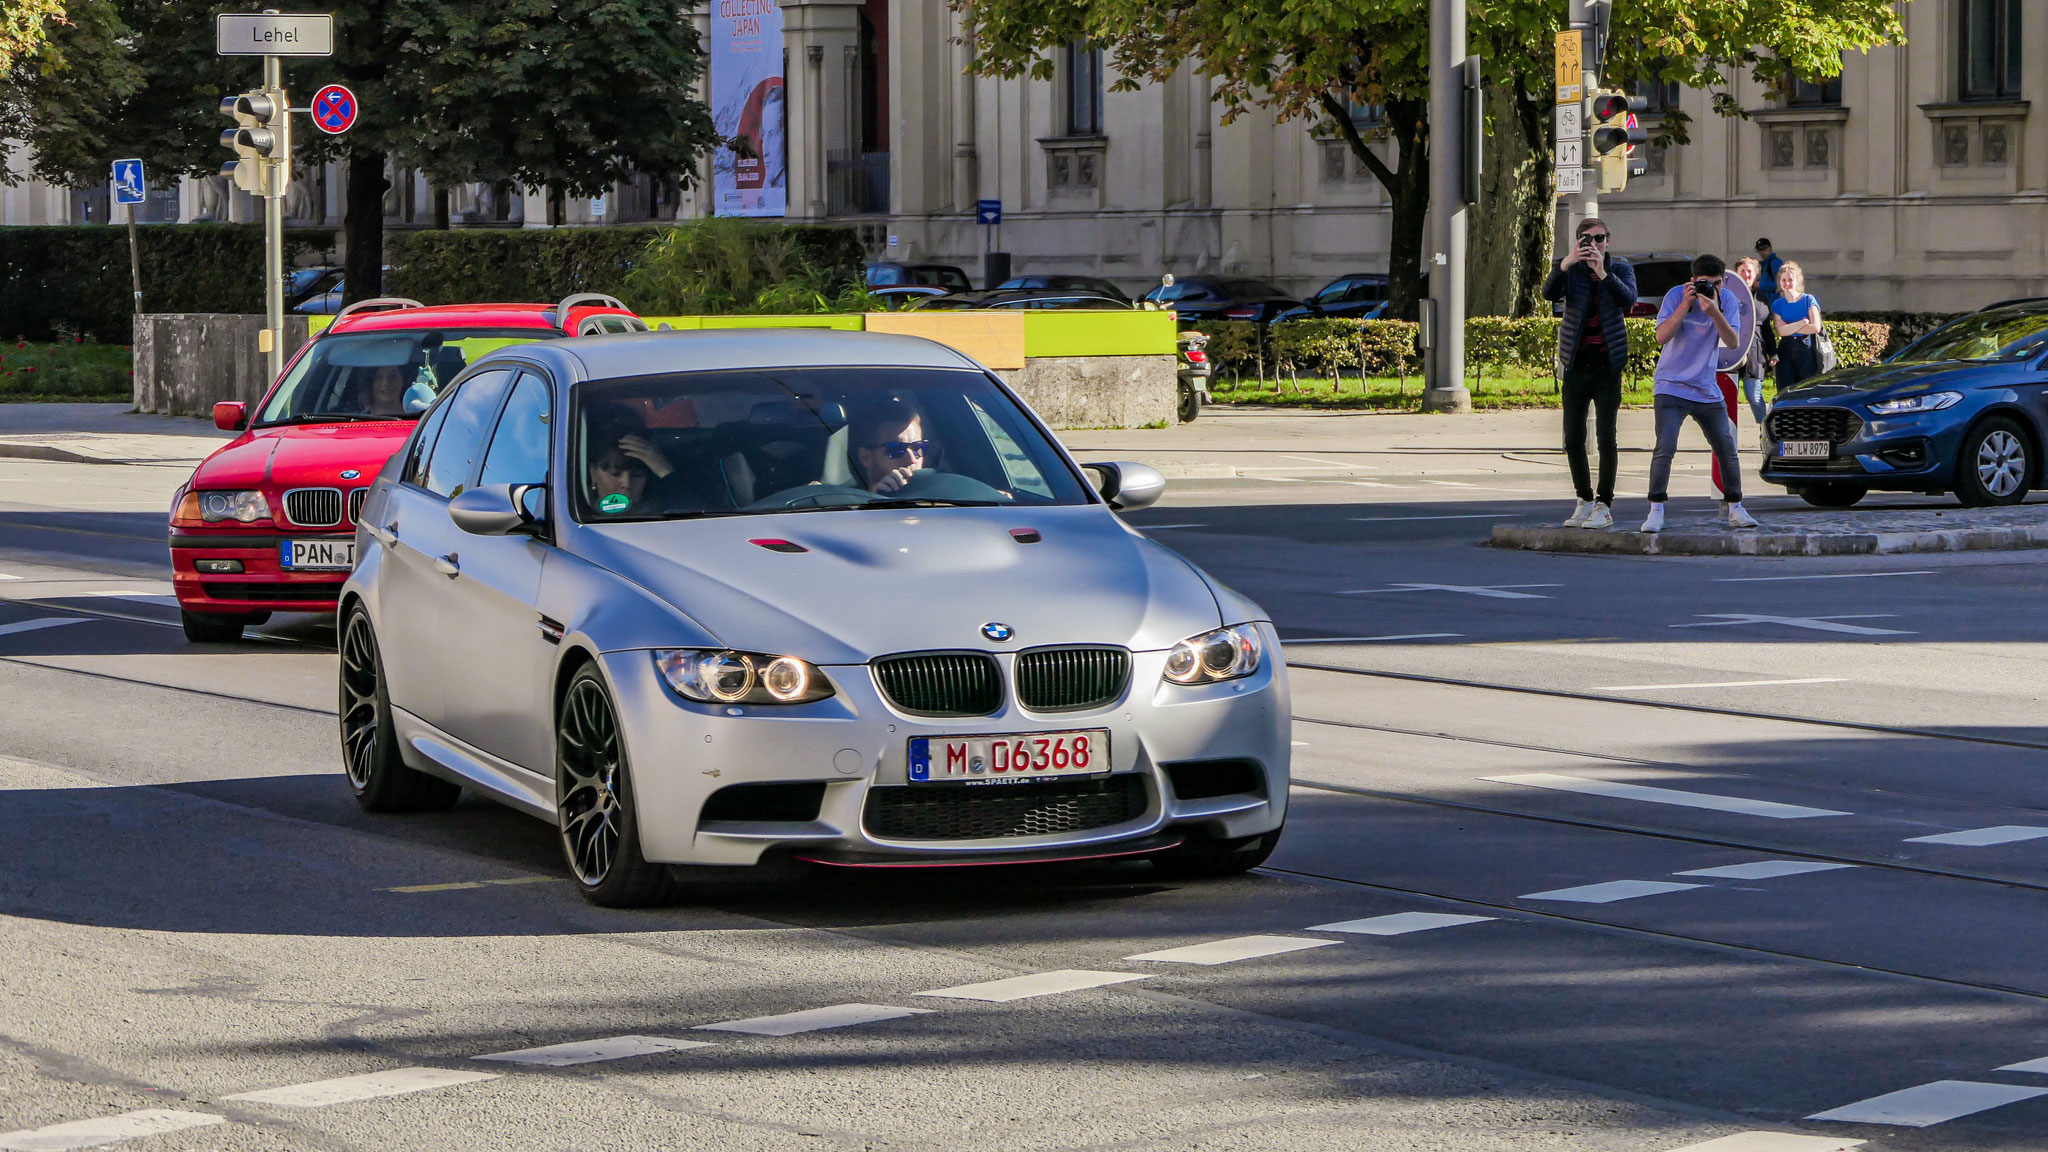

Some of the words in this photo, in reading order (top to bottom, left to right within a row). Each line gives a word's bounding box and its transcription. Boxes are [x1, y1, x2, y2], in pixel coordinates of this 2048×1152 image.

[721, 0, 772, 18] COLLECTING
[253, 26, 299, 42] Lehel
[732, 18, 760, 37] JAPAN
[1783, 443, 1794, 455] HH
[1798, 443, 1808, 455] LW
[1809, 443, 1829, 455] 8979
[293, 543, 333, 564] PAN
[915, 763, 923, 774] D
[946, 741, 968, 774] M
[991, 736, 1090, 773] 06368
